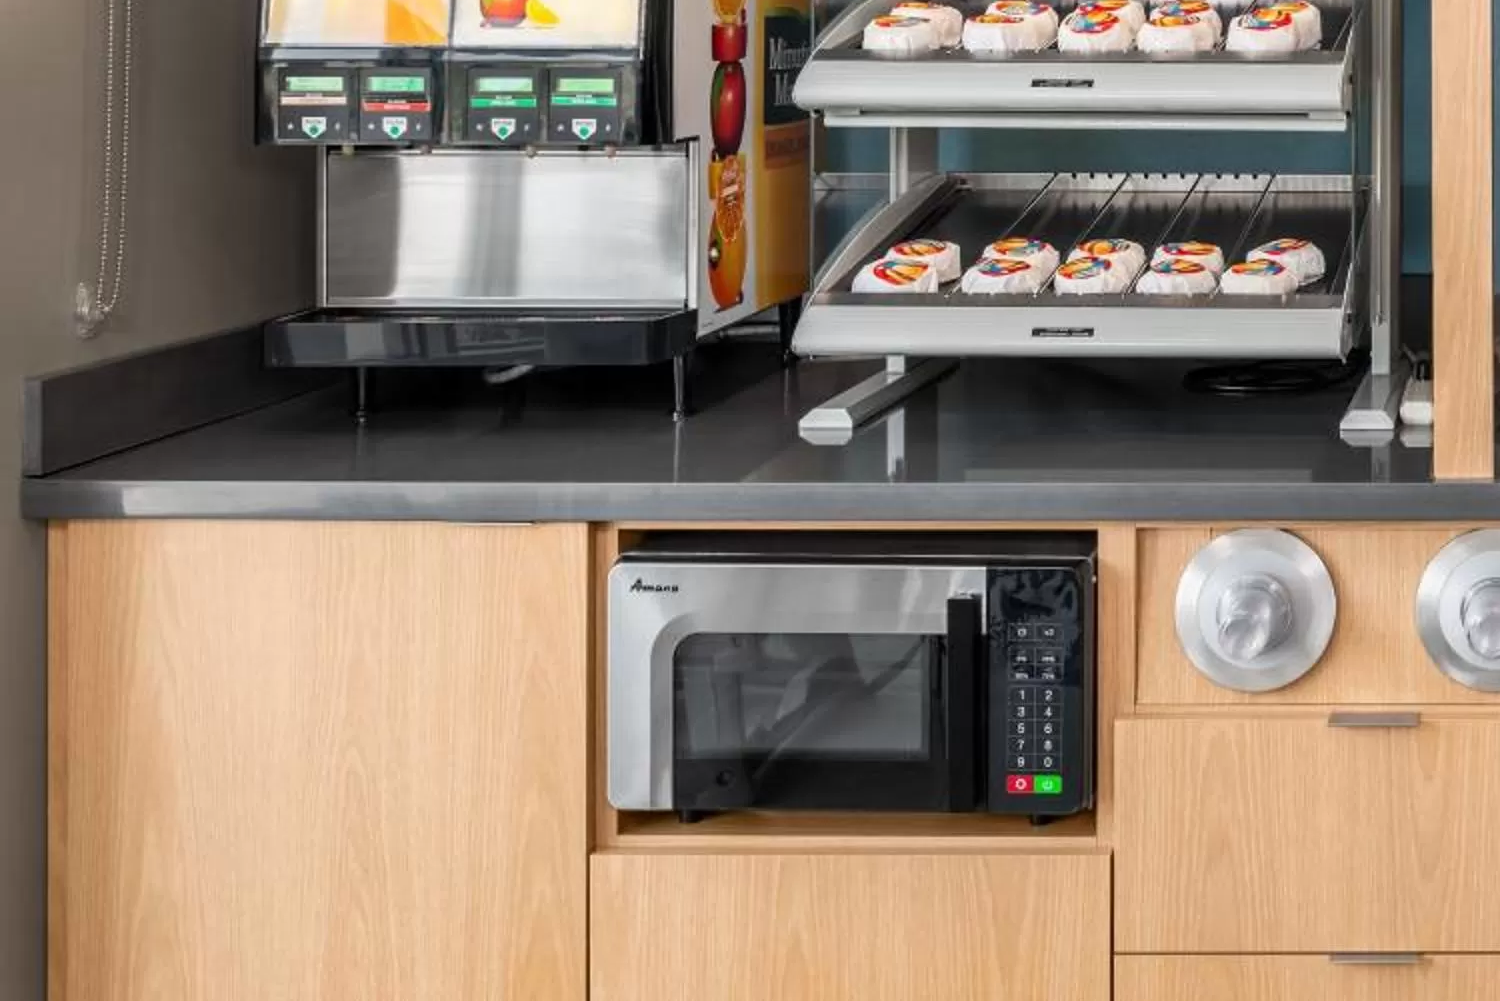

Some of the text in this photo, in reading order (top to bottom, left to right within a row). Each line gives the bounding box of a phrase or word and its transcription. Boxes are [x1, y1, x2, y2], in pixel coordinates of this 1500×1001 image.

[1018, 690, 1025, 700] 1
[1017, 706, 1025, 717] 3
[1017, 722, 1025, 734] 5
[1018, 739, 1025, 750] 7
[1017, 756, 1025, 767] 9
